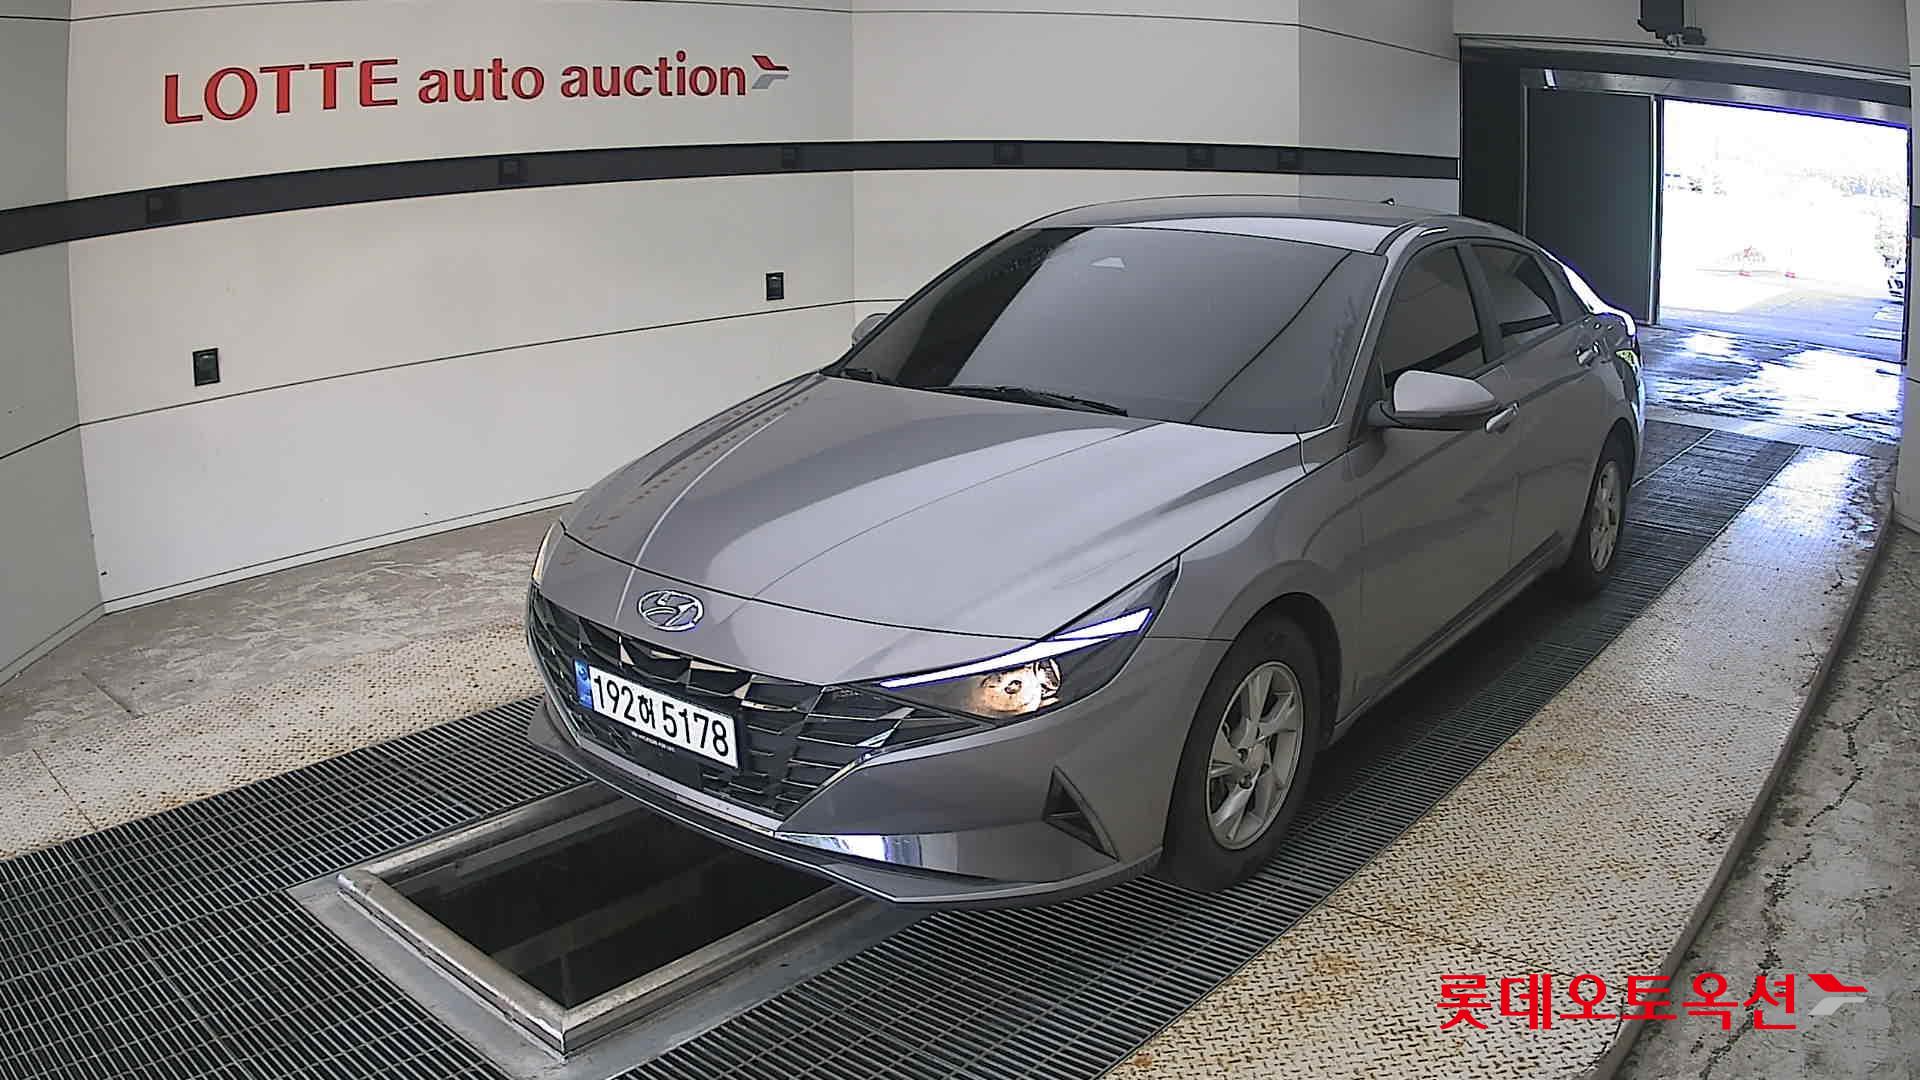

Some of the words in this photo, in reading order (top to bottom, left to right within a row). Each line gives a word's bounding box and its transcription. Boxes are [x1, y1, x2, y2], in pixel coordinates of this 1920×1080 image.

[164, 58, 399, 125] LOTTE
[418, 57, 546, 104] auto
[560, 50, 747, 98] auction
[593, 674, 656, 730] 192허
[662, 701, 730, 758] 5178
